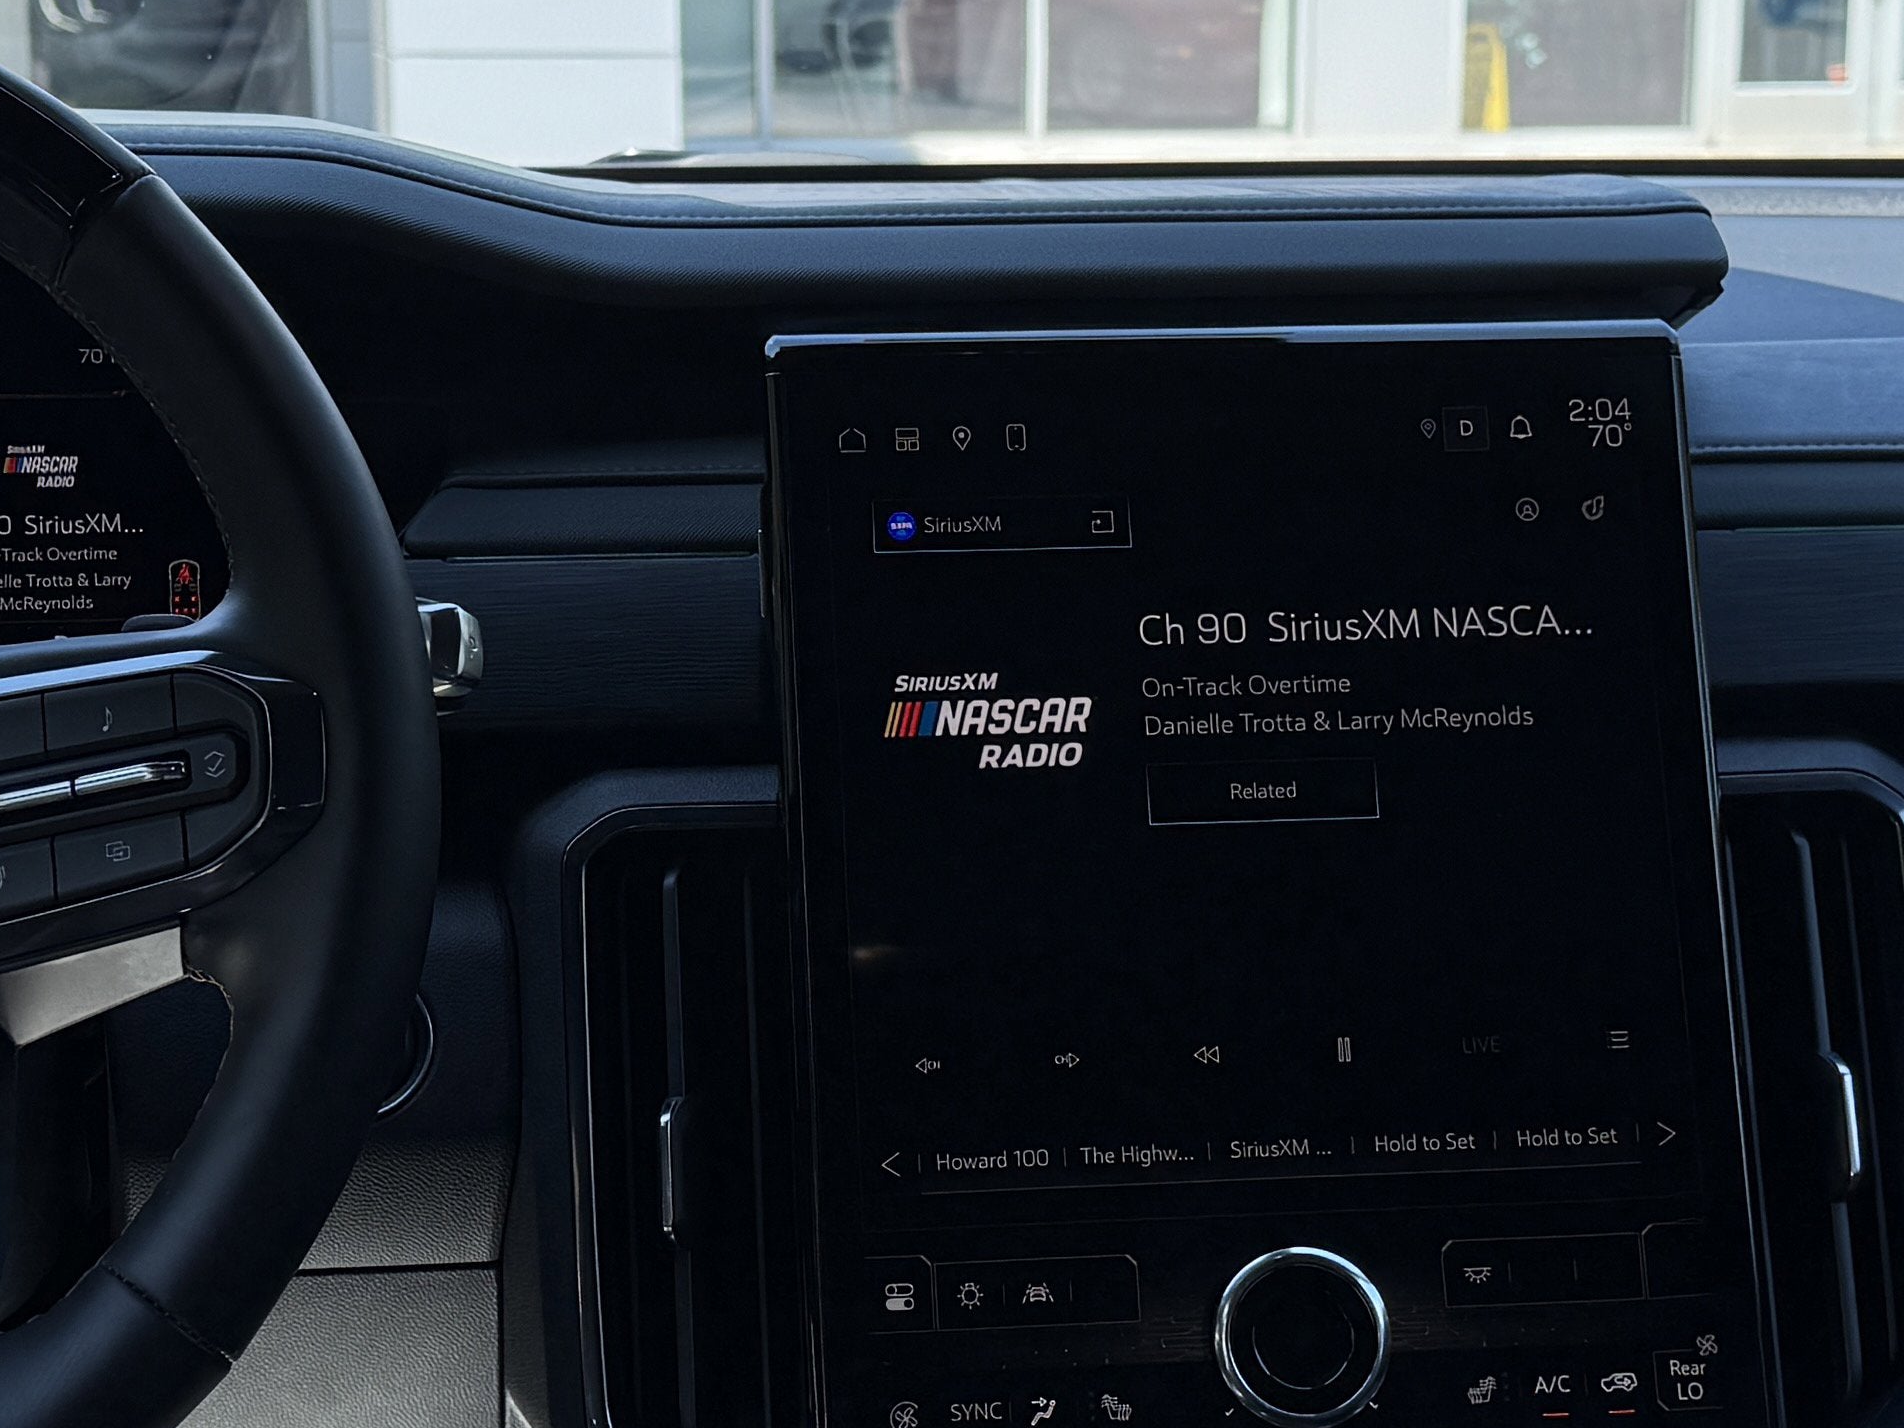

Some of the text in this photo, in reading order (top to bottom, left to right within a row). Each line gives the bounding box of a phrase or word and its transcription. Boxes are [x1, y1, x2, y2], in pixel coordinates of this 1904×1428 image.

[1568, 397, 1632, 422] 2:04
[1459, 419, 1474, 437] D
[1587, 422, 1632, 448] 70°
[21, 456, 78, 473] NASCAR
[36, 476, 75, 488] RADIO
[924, 515, 1002, 534] SiriusXM
[47, 546, 118, 562] Overtime
[26, 574, 73, 588] Trotta
[77, 575, 89, 587] &
[94, 573, 132, 590] Larry
[0, 595, 94, 613] McReynolds
[1138, 604, 1594, 646] Ch 90 SiriusXM NASCA...
[1141, 673, 1351, 699] On-Track Overtime
[935, 696, 1093, 736] NASCAR
[1145, 705, 1534, 737] Danielle Trotta & Larry McReynolds
[979, 742, 1083, 770] RADIO
[1230, 781, 1297, 800] Related
[1462, 1036, 1501, 1055] LIVE
[1374, 1133, 1476, 1153] Hold to Set
[1517, 1126, 1618, 1148] Hold to Set
[1080, 1143, 1195, 1169] The Highw...
[1230, 1138, 1309, 1160] SiriusXM
[936, 1148, 1049, 1172] Howard 100
[1669, 1359, 1706, 1376] Rear
[1535, 1374, 1571, 1395] A/C
[1676, 1382, 1704, 1401] LO
[950, 1401, 1003, 1422] SYNC
